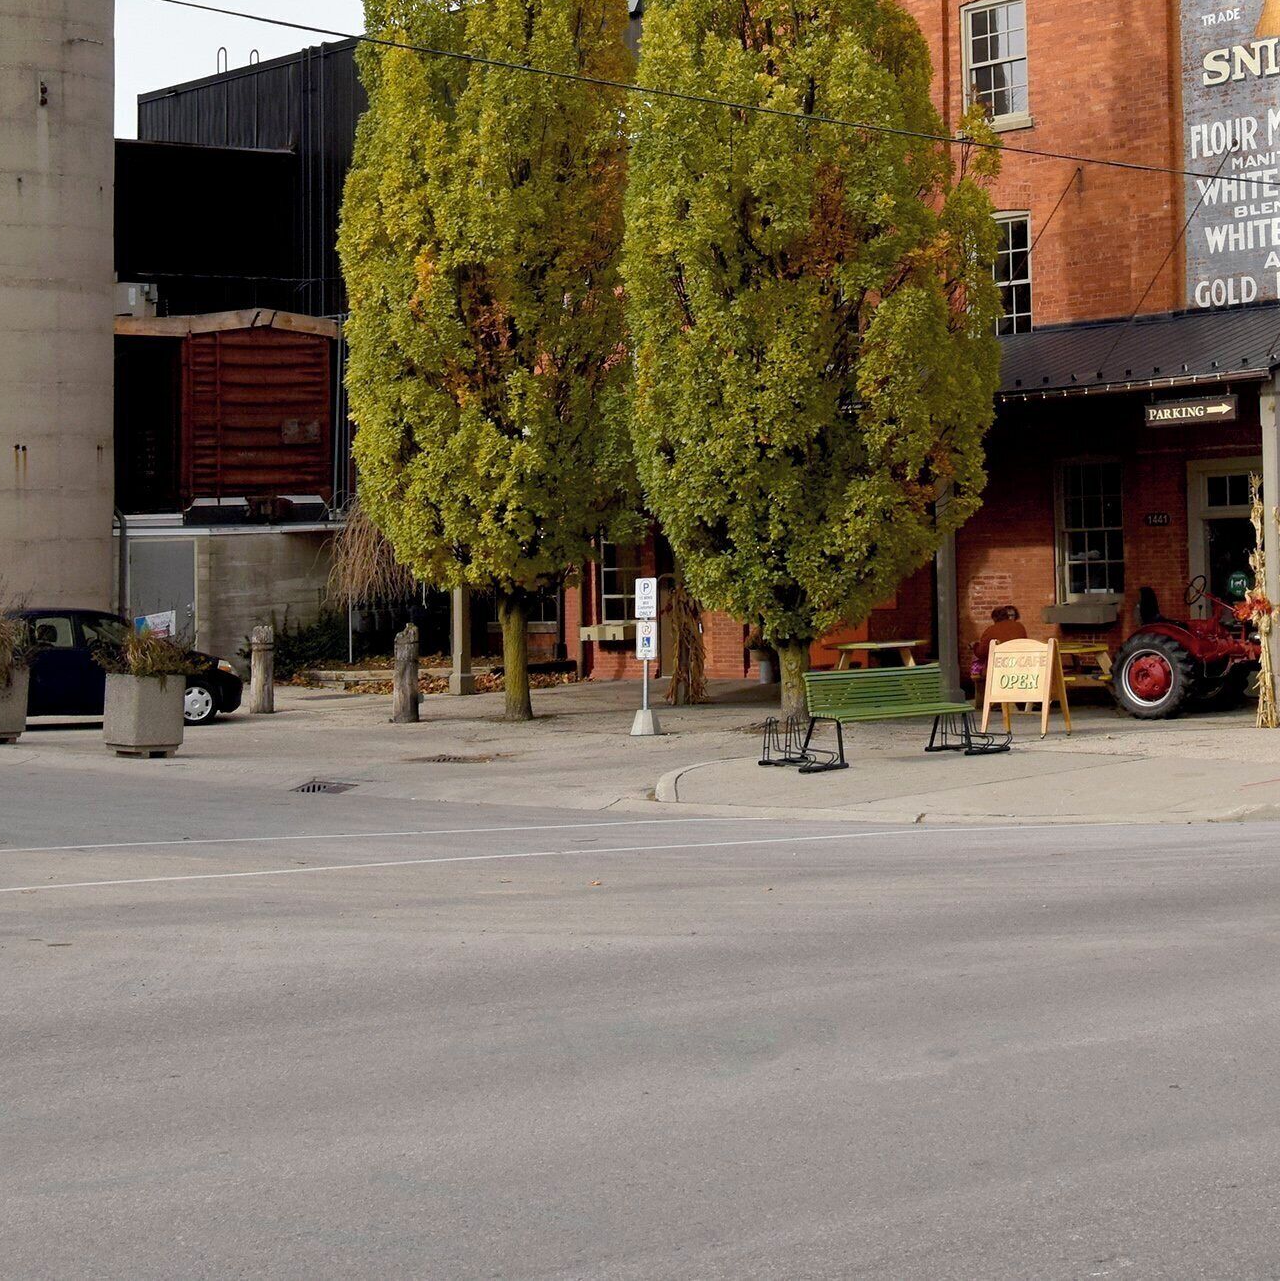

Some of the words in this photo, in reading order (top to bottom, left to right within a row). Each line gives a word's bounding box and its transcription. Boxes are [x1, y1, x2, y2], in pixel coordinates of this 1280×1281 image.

[1201, 8, 1241, 26] TRADE
[1190, 116, 1258, 159] FLOUR
[1197, 168, 1279, 206] WHITE
[1194, 276, 1258, 308] GOLD
[1148, 406, 1205, 421] PARKING
[1148, 515, 1168, 525] 1441
[1000, 673, 1039, 689] OPEN
